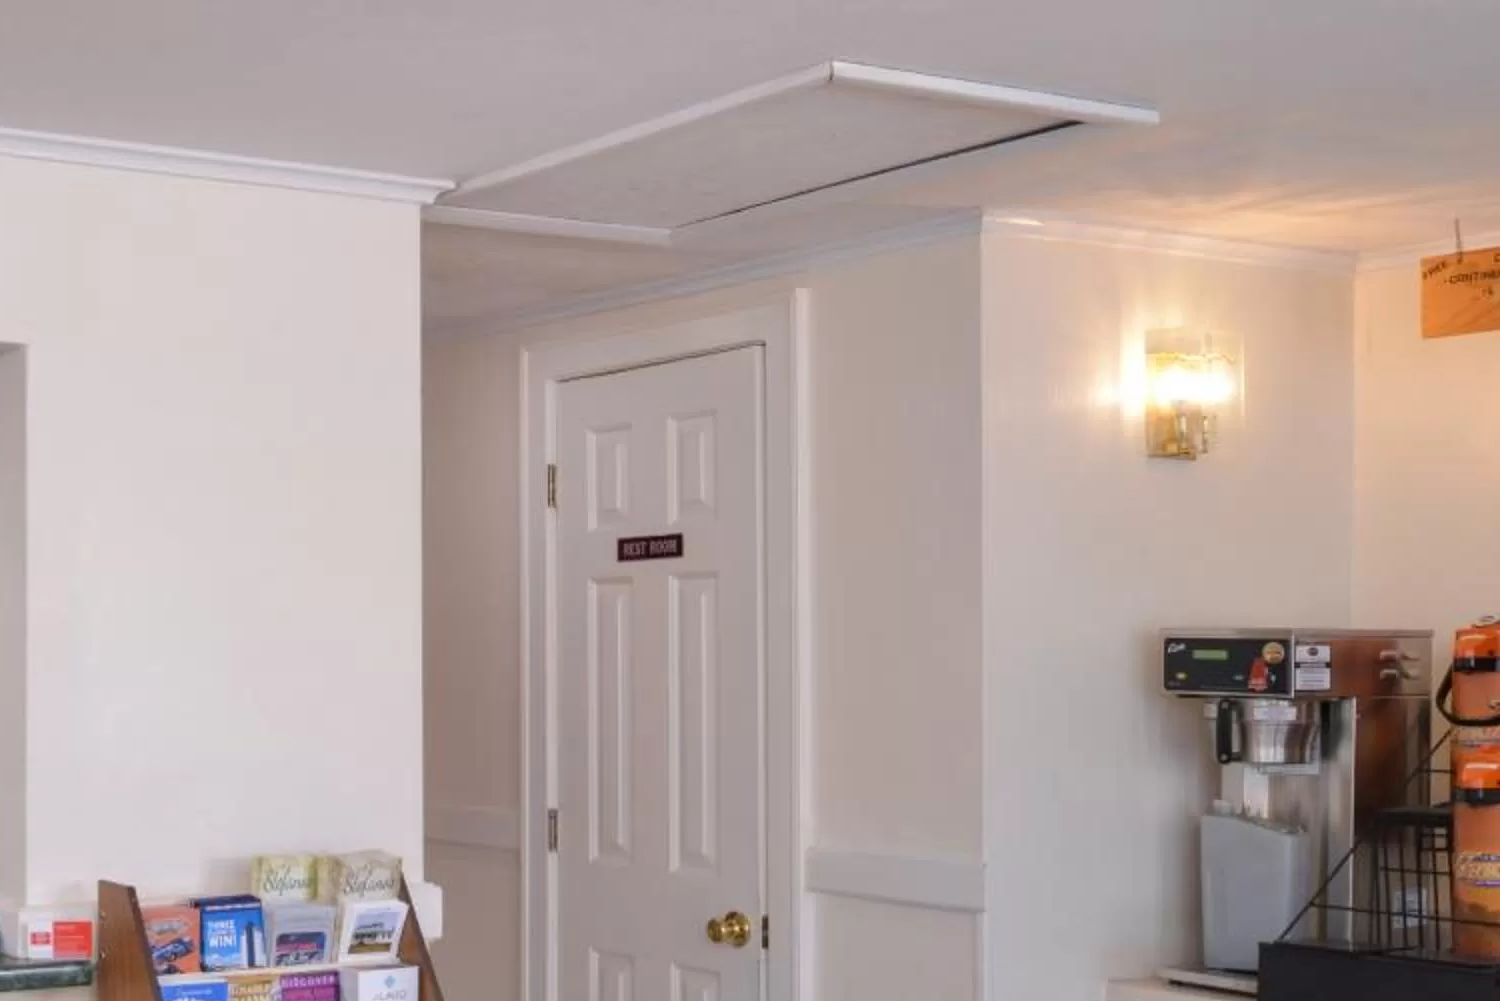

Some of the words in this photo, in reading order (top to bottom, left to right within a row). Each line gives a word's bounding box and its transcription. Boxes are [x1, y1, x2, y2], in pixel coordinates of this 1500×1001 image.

[623, 542, 647, 556] REST
[649, 540, 677, 554] ROOM
[282, 975, 334, 987] DISCOVER
